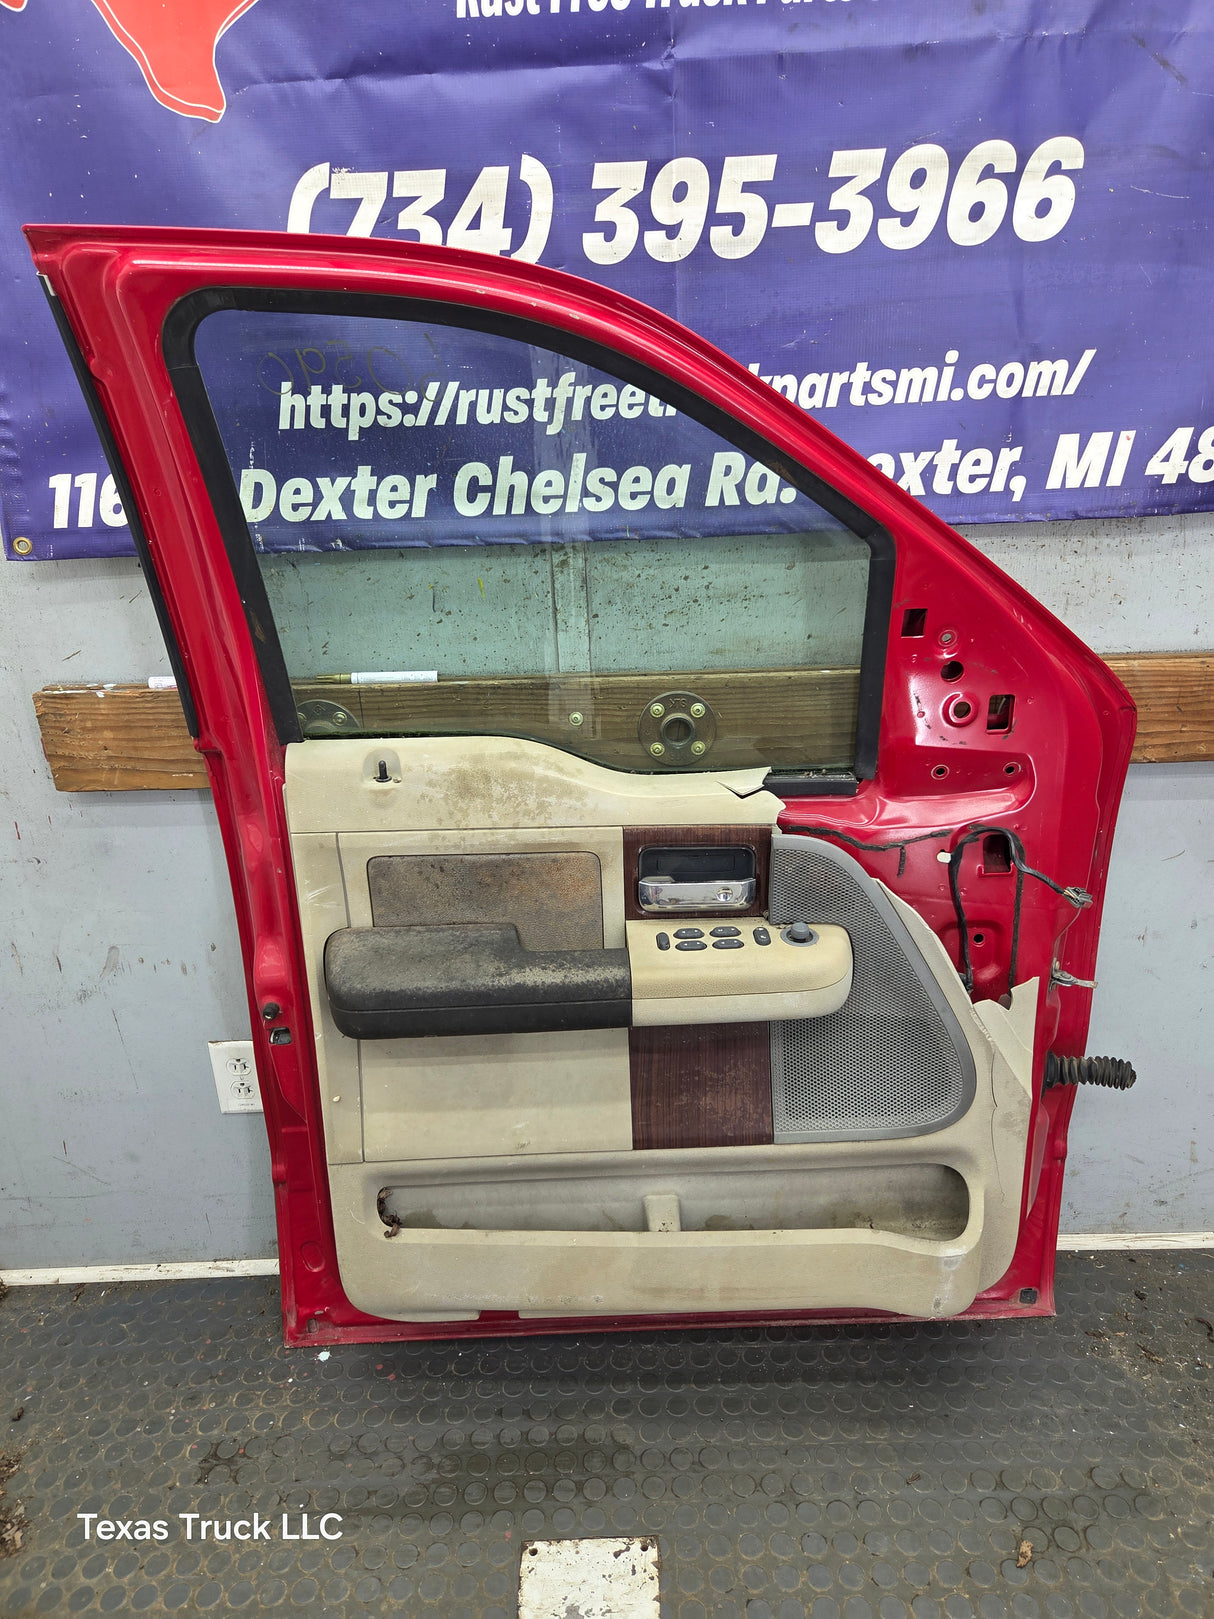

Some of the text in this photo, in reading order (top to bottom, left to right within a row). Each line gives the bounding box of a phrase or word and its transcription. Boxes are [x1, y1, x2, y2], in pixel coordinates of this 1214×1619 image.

[287, 135, 1085, 265] (734) 395-3966
[239, 465, 437, 523] Dexter
[453, 453, 691, 517] Chelsea
[704, 451, 797, 507] Rd.
[1045, 429, 1137, 490] MI
